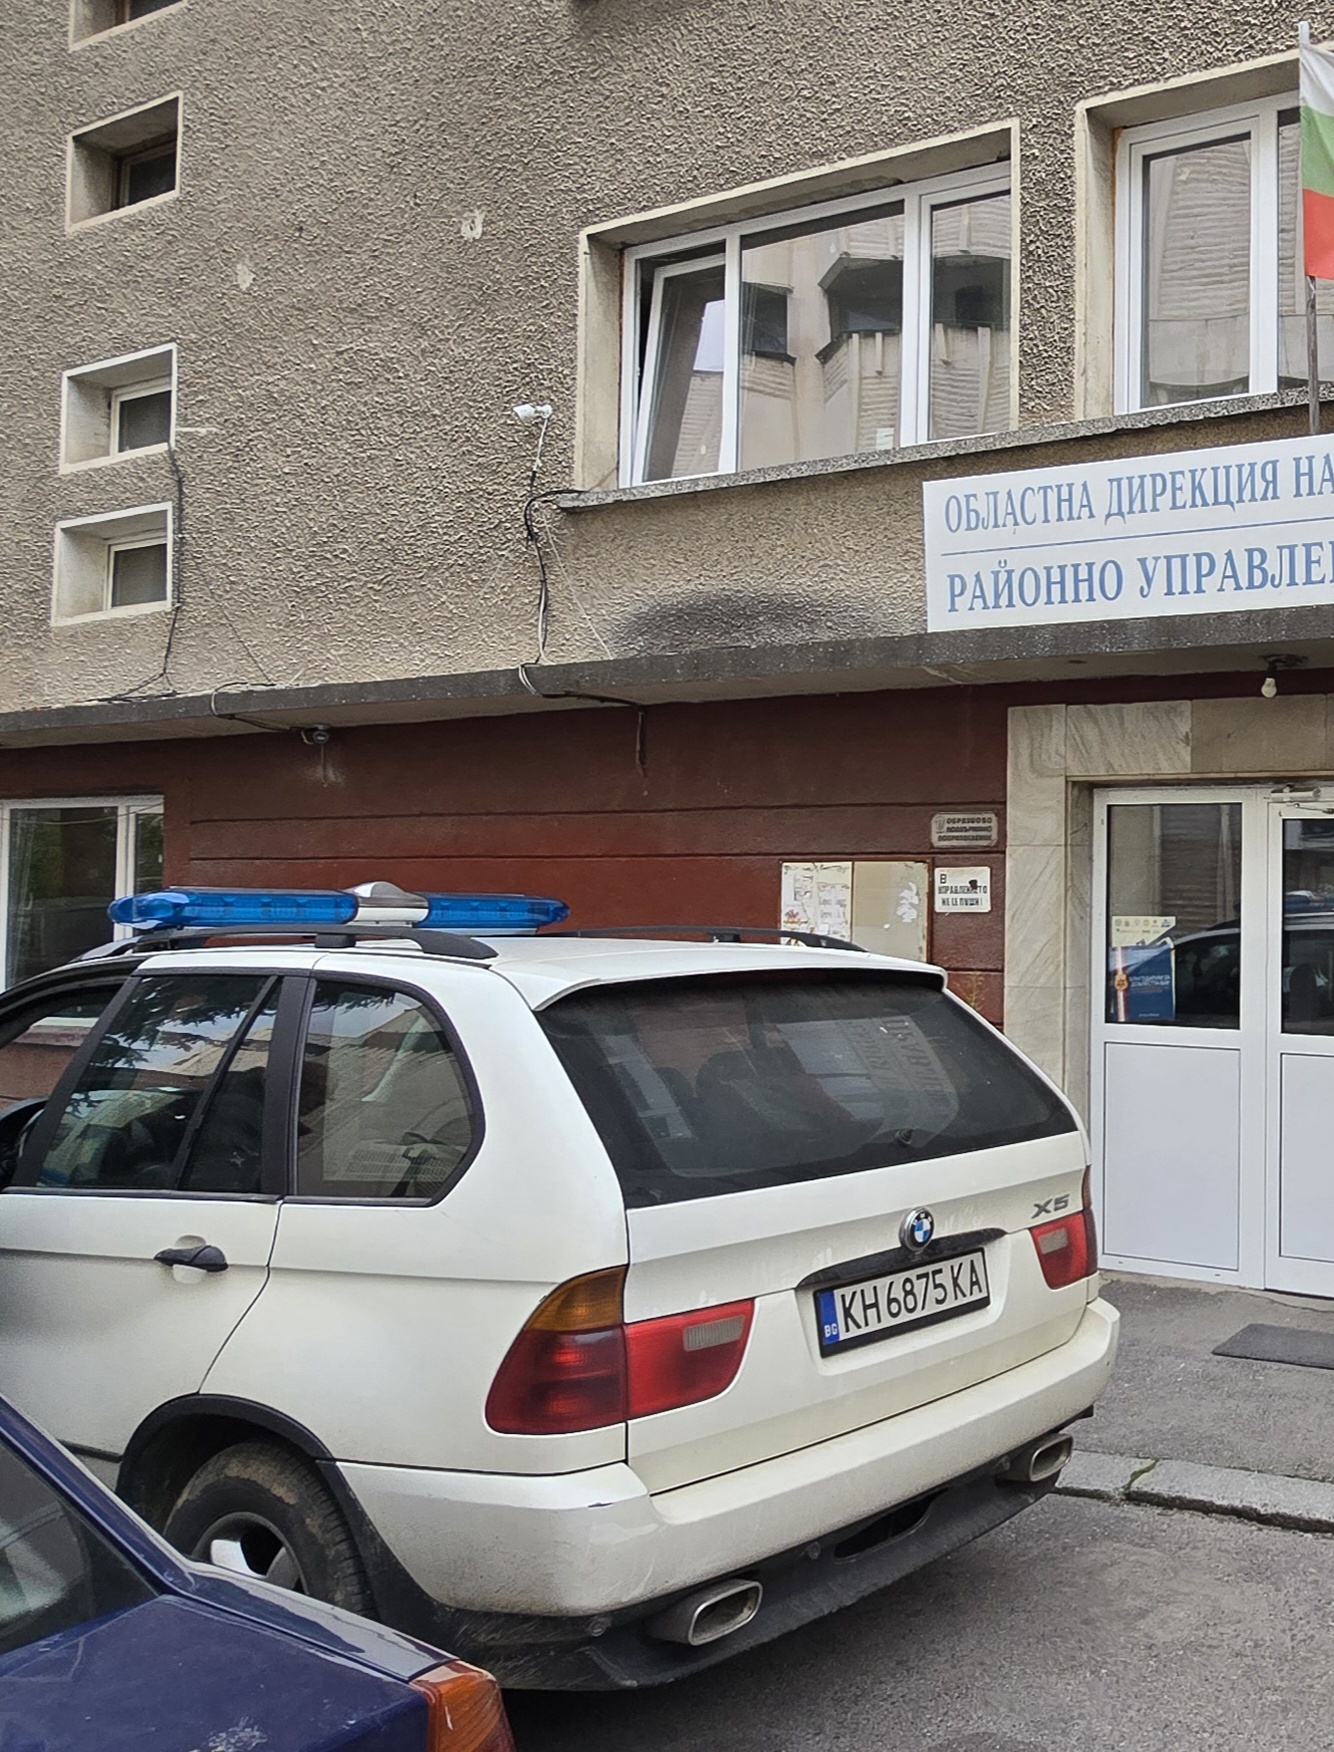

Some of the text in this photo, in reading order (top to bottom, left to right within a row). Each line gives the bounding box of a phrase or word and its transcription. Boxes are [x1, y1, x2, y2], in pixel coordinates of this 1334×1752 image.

[945, 480, 1096, 533] ОБЛАСТНА
[1105, 458, 1281, 526] ДИРЕКЦИЯ
[947, 557, 1124, 613] РАЙОННО
[940, 874, 947, 884] В
[1031, 1193, 1070, 1219] X5
[824, 1323, 838, 1337] BG
